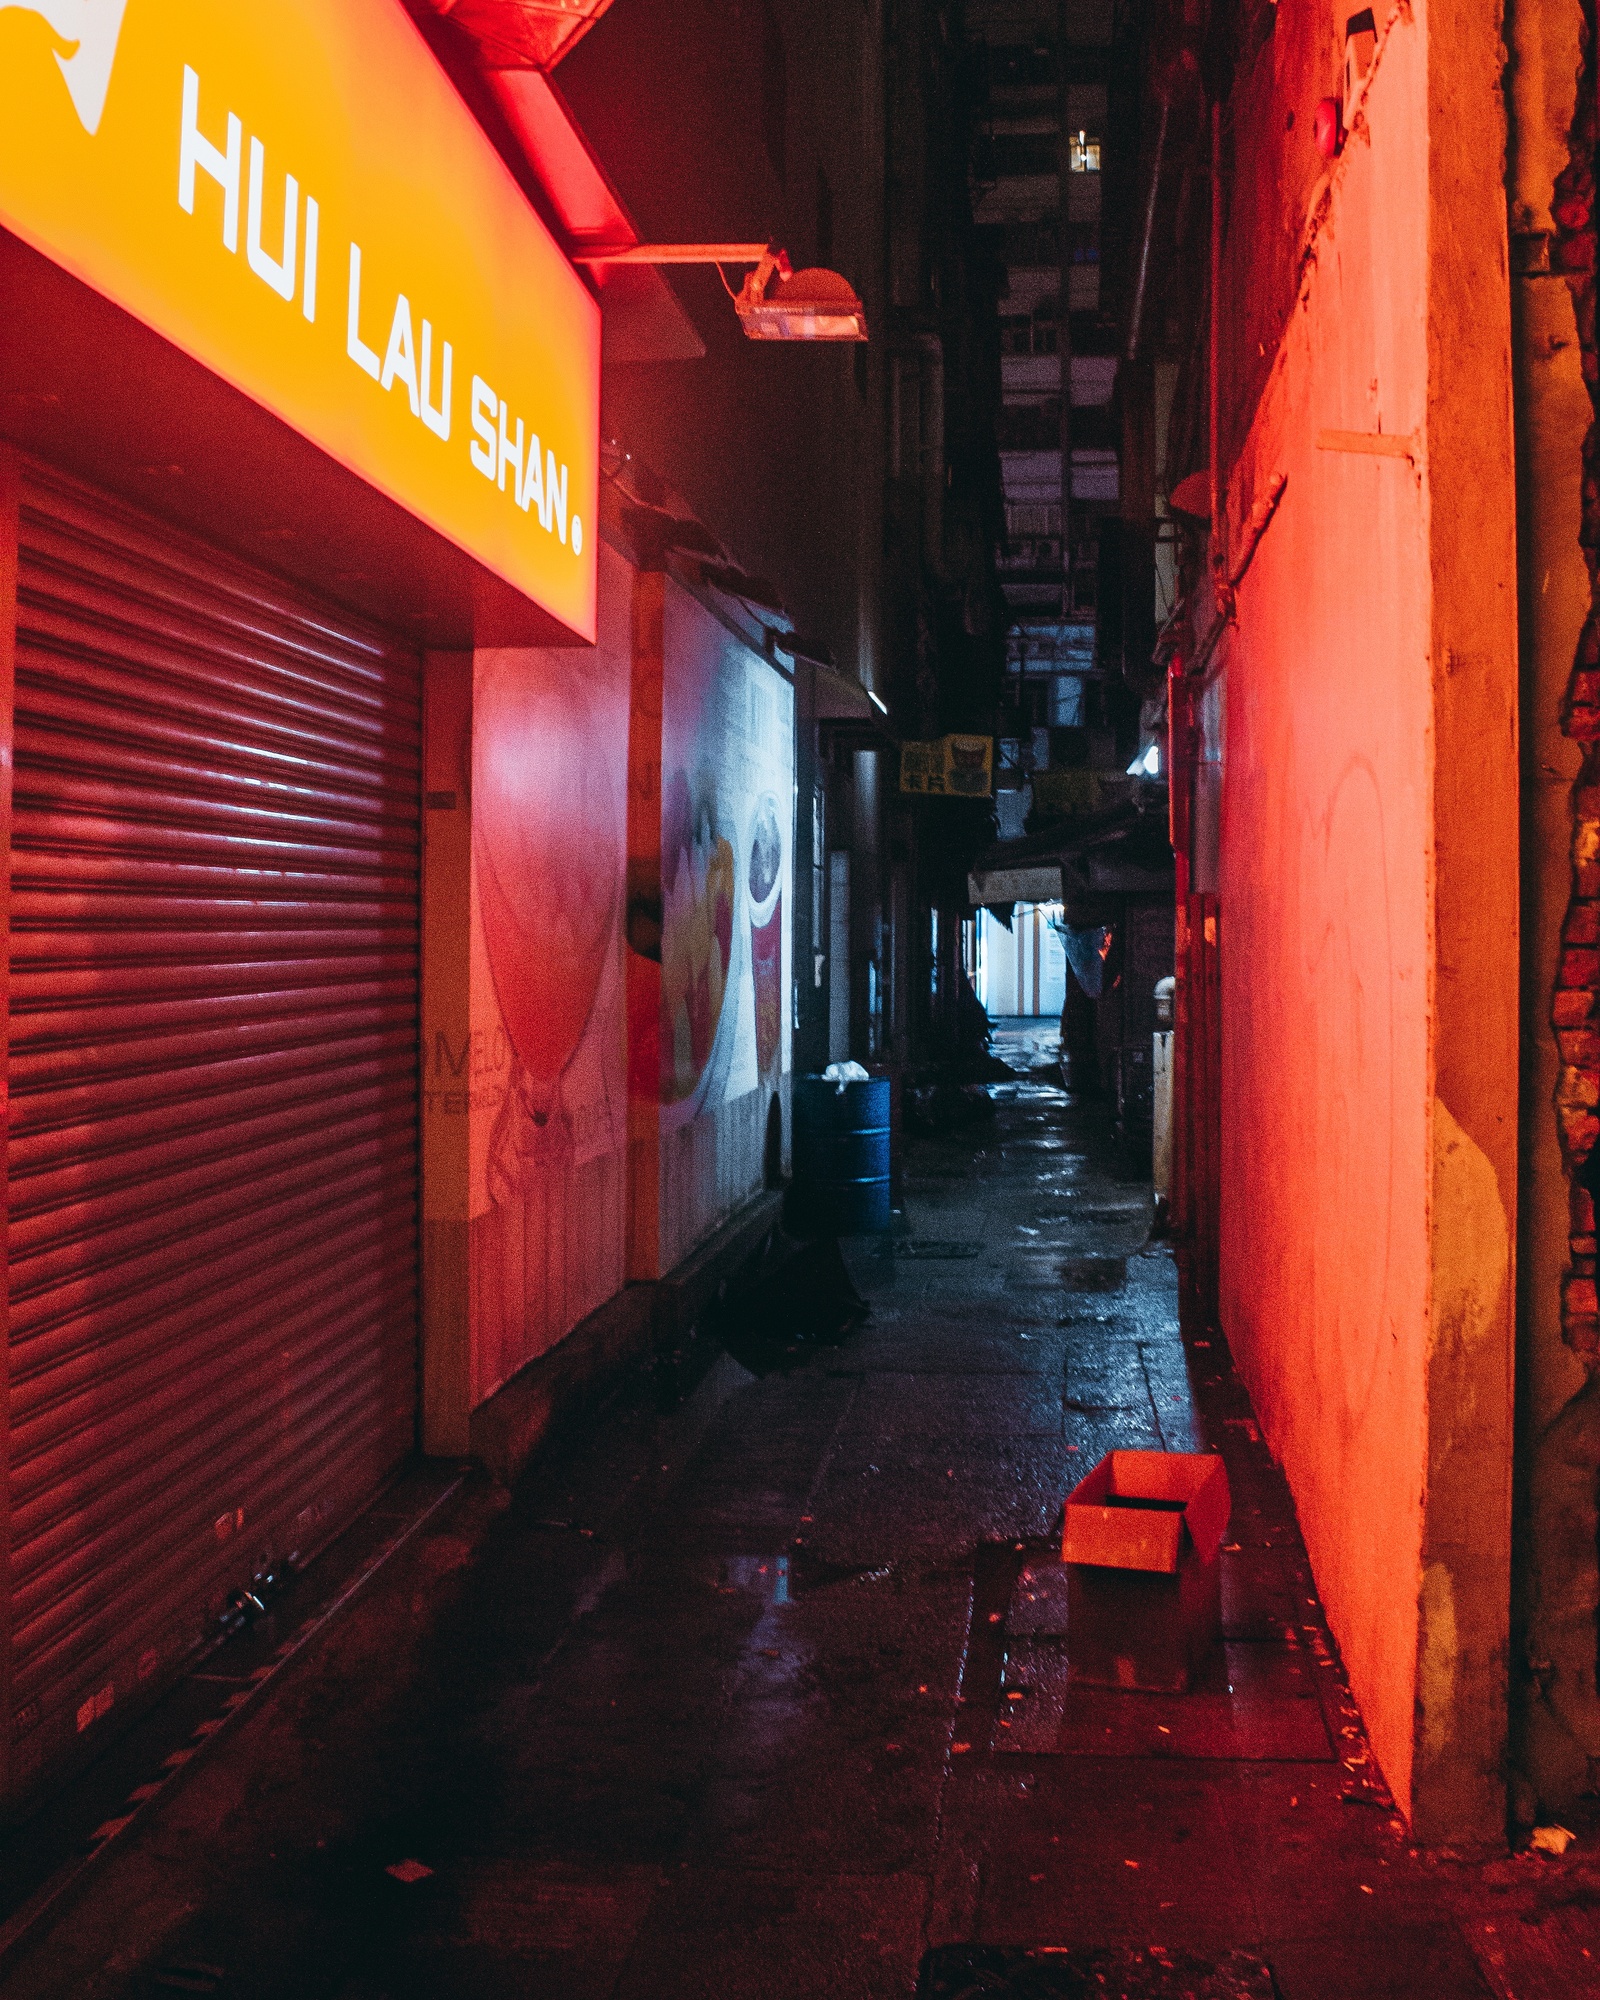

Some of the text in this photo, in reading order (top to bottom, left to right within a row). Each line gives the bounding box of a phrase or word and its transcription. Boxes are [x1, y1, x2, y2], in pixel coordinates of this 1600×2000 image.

[177, 62, 319, 324] HUI
[346, 242, 454, 443] LAU
[469, 373, 569, 546] SHAN
